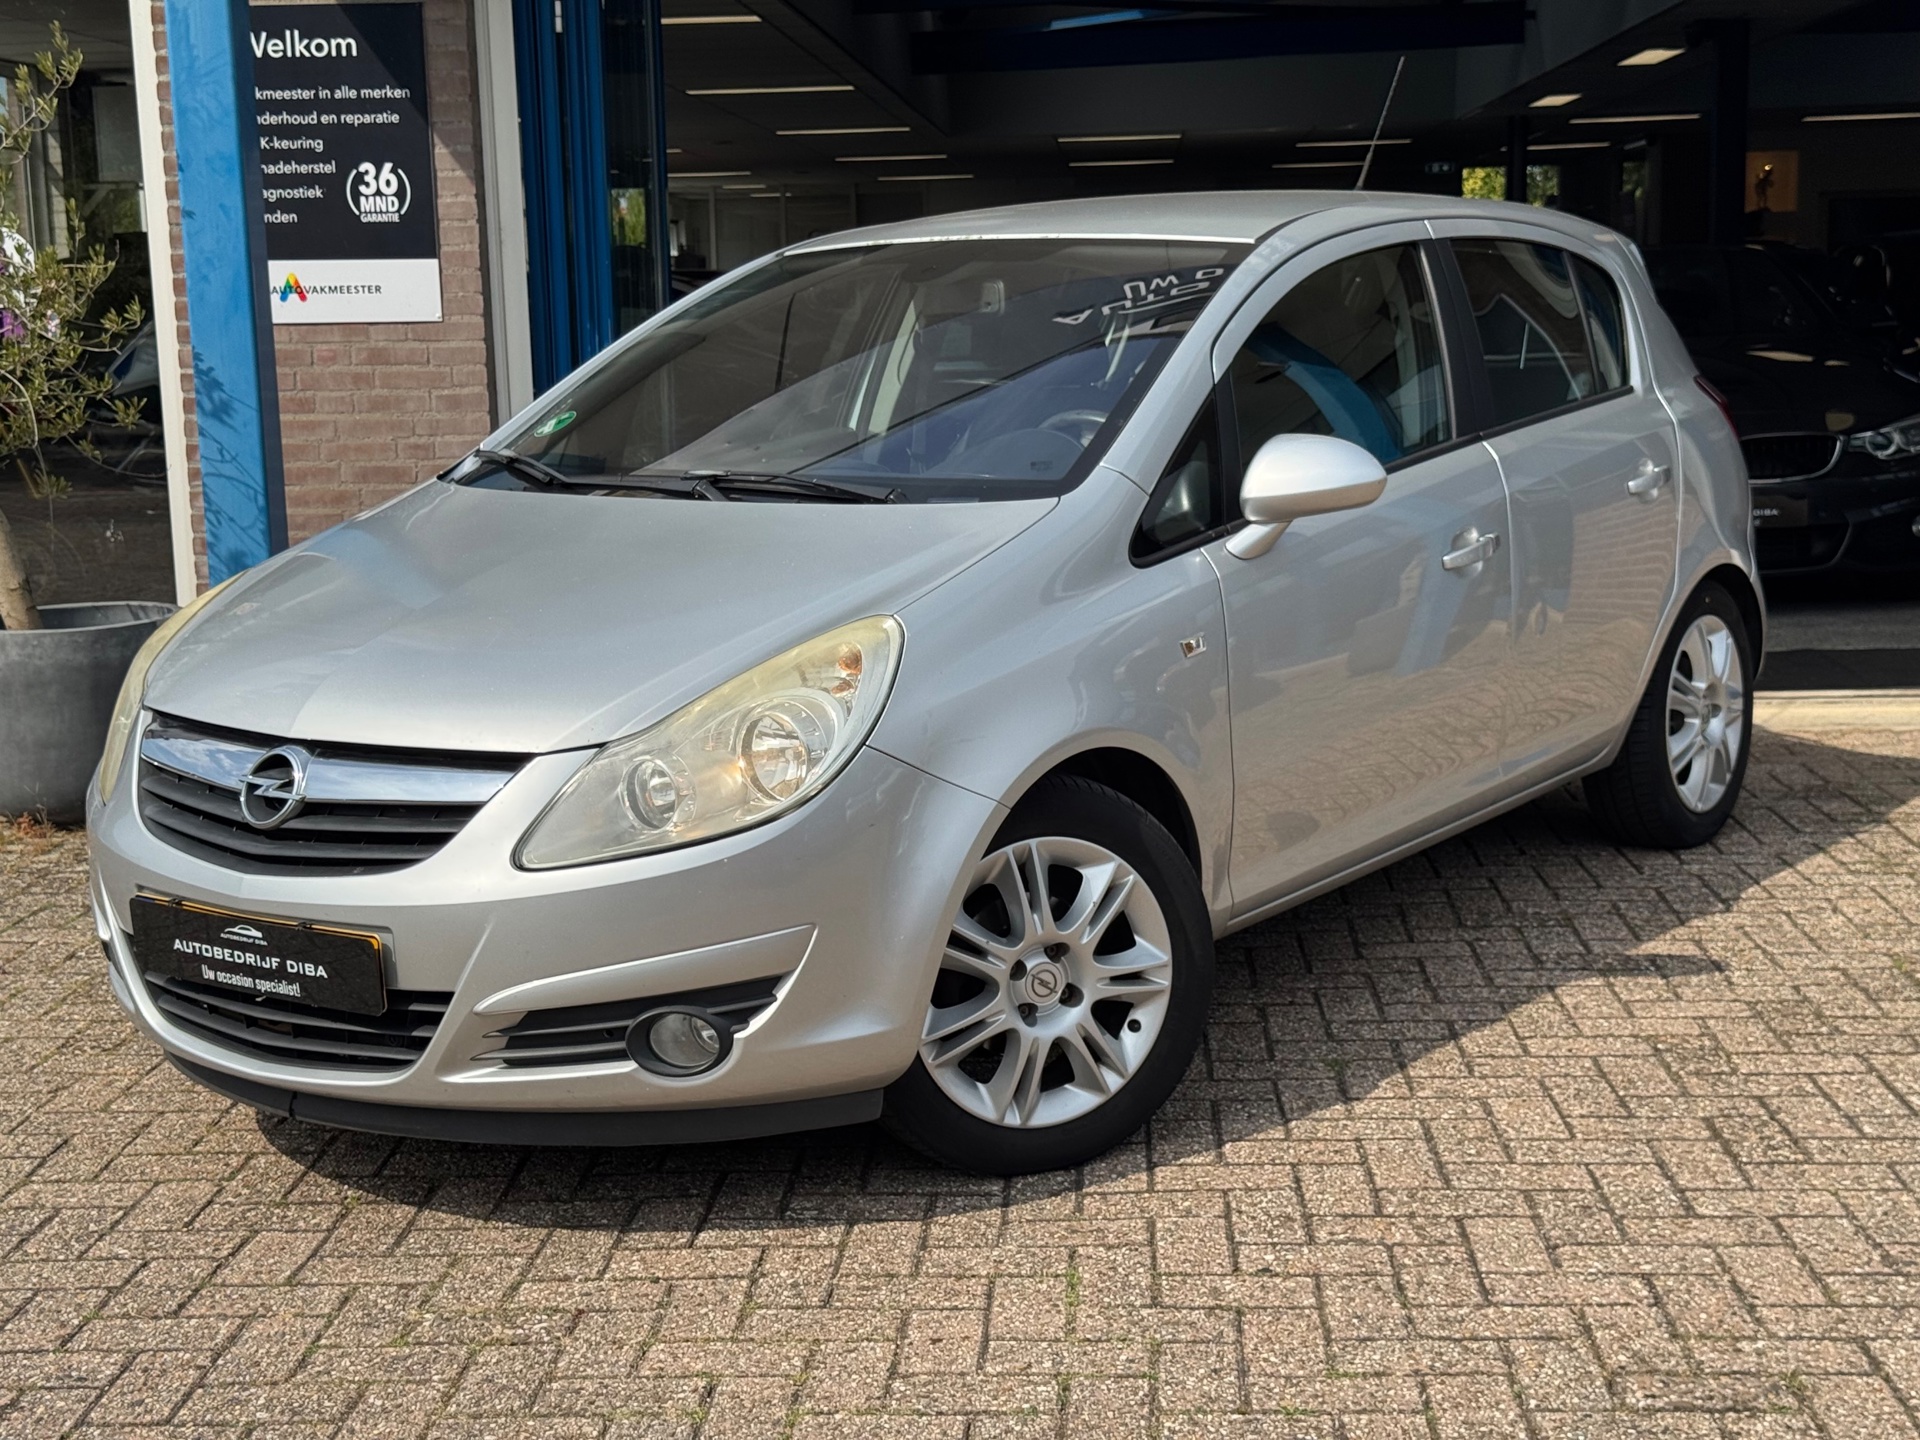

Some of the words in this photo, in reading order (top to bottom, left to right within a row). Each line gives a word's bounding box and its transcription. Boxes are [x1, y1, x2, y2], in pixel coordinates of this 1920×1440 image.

[318, 86, 331, 99] in
[333, 84, 358, 99] alle
[360, 84, 411, 99] merken
[320, 112, 338, 125] en
[340, 110, 400, 127] reparatie
[357, 161, 399, 196] 36
[360, 196, 400, 212] MND
[360, 213, 400, 223] GARANTIE
[271, 284, 382, 295] AUTOVAKMEESTER
[173, 938, 280, 970] AUTOBEDRIJF
[286, 960, 328, 979] DIBA
[201, 963, 215, 981] Uw
[216, 971, 254, 989] occasion
[255, 978, 301, 998] specialist!
